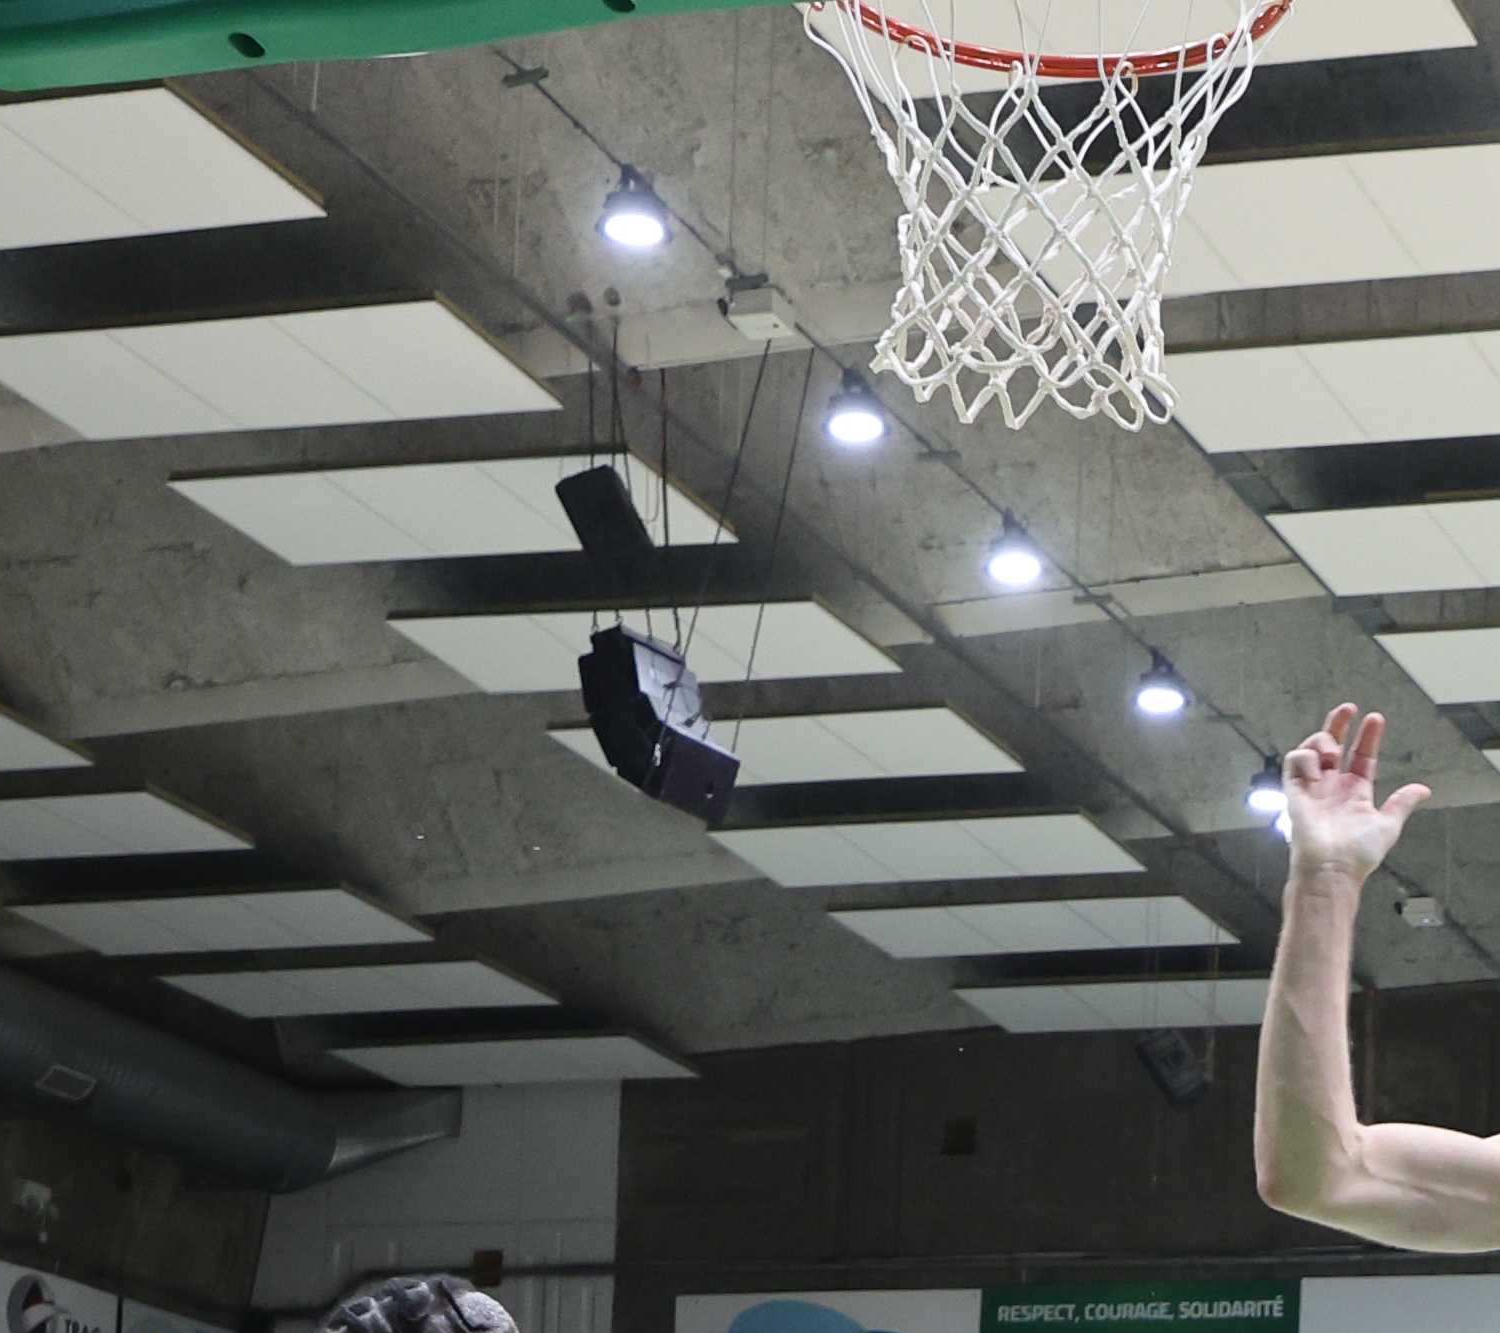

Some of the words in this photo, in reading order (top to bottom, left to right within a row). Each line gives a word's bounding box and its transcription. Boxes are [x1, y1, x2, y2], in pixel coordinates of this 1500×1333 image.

[998, 1304, 1079, 1323] RESPECT,
[1084, 1301, 1175, 1321] COURAGE,
[1179, 1295, 1284, 1319] SOLIDARITÉ
